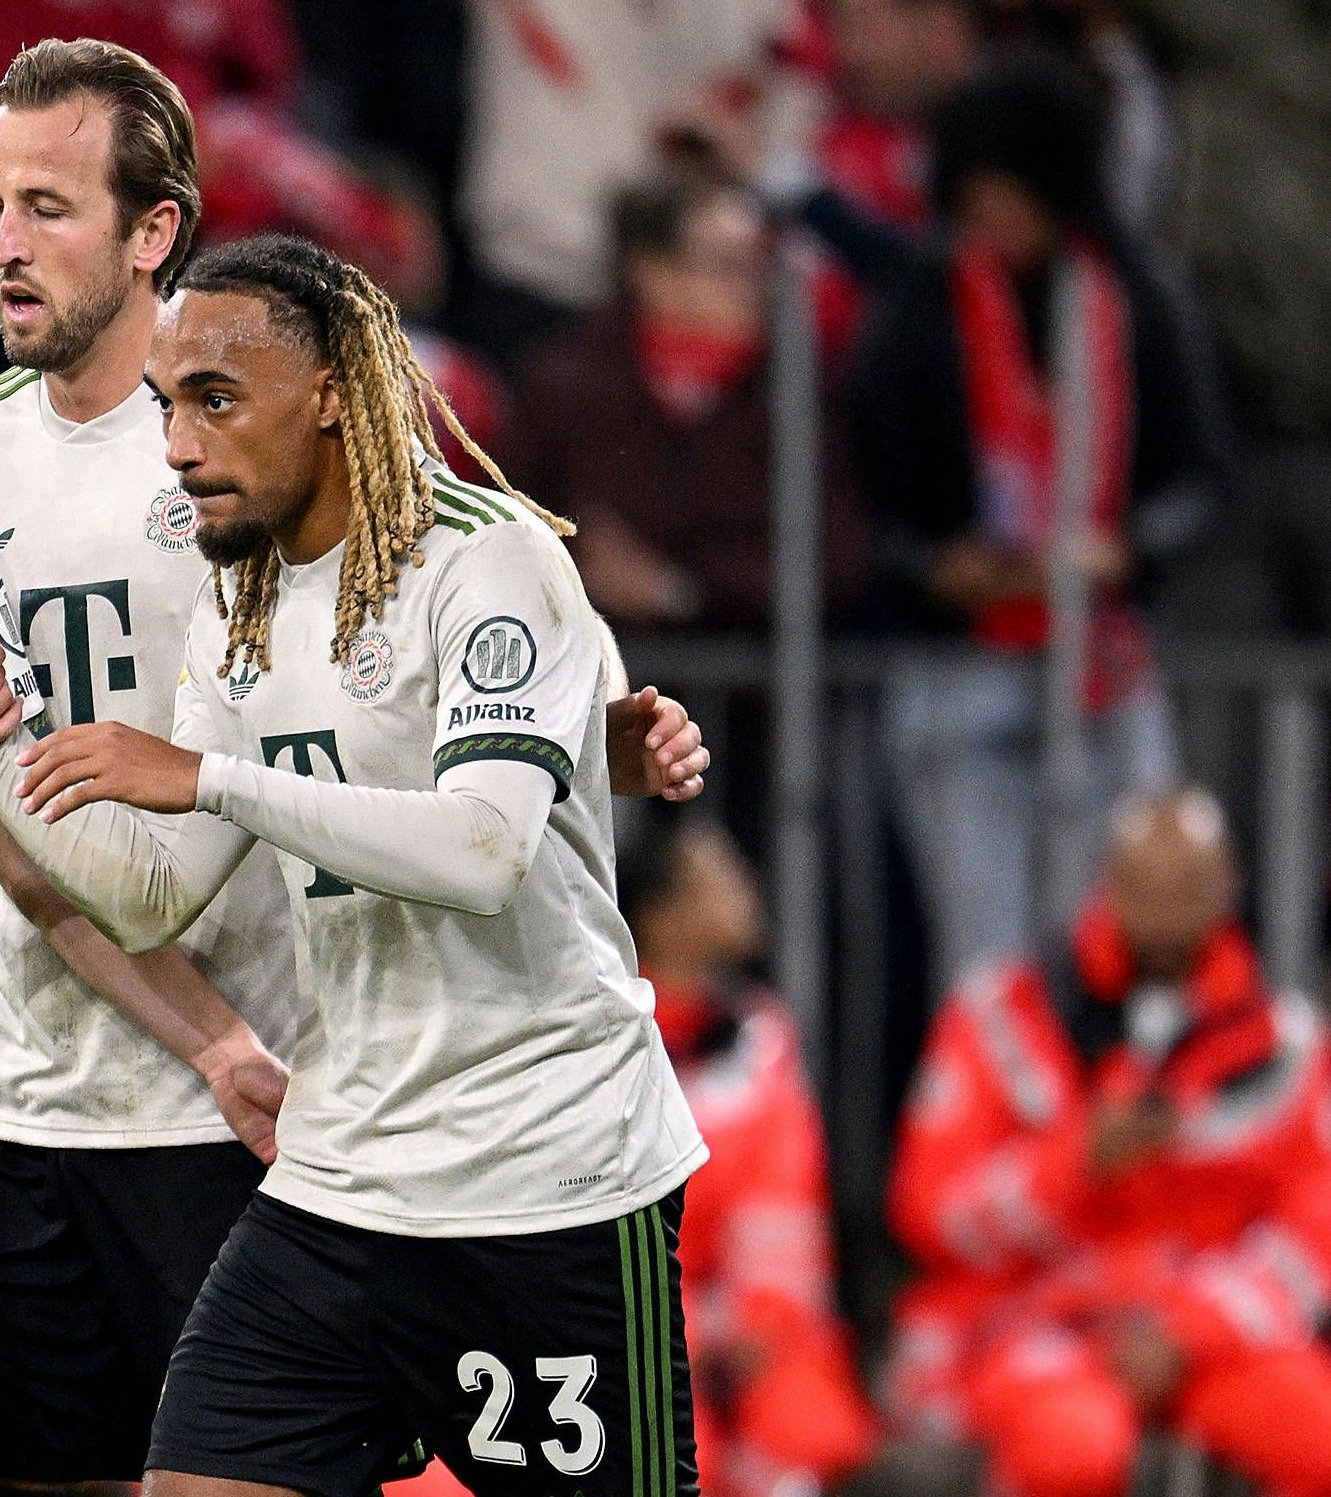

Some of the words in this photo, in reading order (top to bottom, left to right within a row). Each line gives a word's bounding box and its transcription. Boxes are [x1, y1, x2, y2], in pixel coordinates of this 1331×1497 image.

[146, 523, 198, 550] Münche
[11, 669, 38, 698] Alli
[447, 703, 536, 731] Allianz
[558, 1174, 602, 1188] AEROREADY
[457, 1350, 606, 1476] 23
